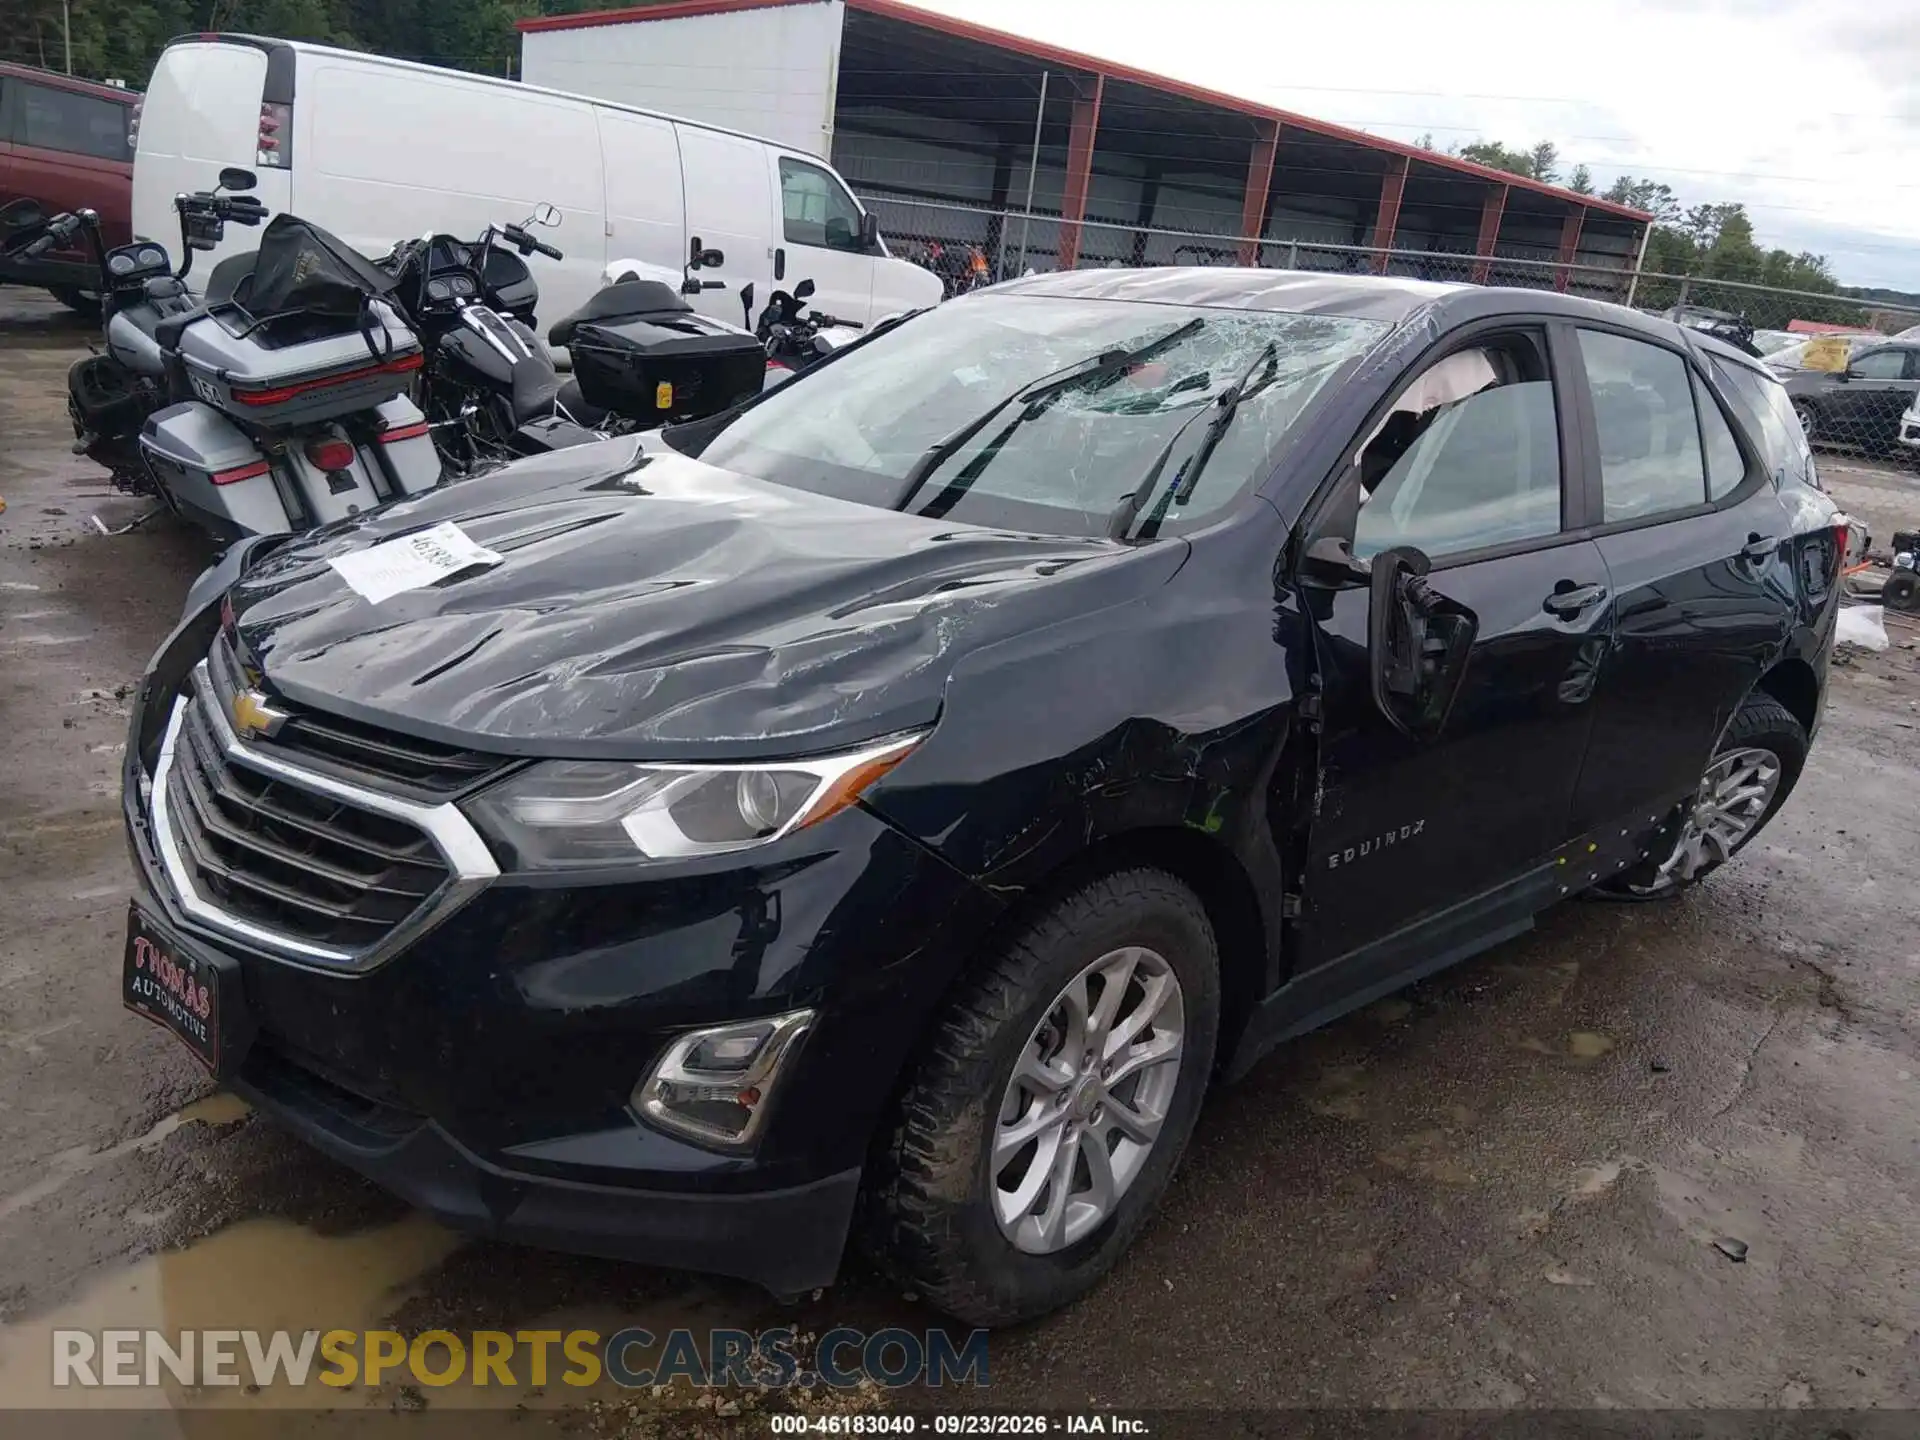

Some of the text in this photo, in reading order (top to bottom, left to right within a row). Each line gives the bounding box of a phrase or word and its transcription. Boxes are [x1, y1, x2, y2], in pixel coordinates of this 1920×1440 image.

[1328, 819, 1425, 869] EQUINOX
[132, 976, 208, 1043] AUTOMOTIVE
[134, 936, 210, 1019] THOMAS
